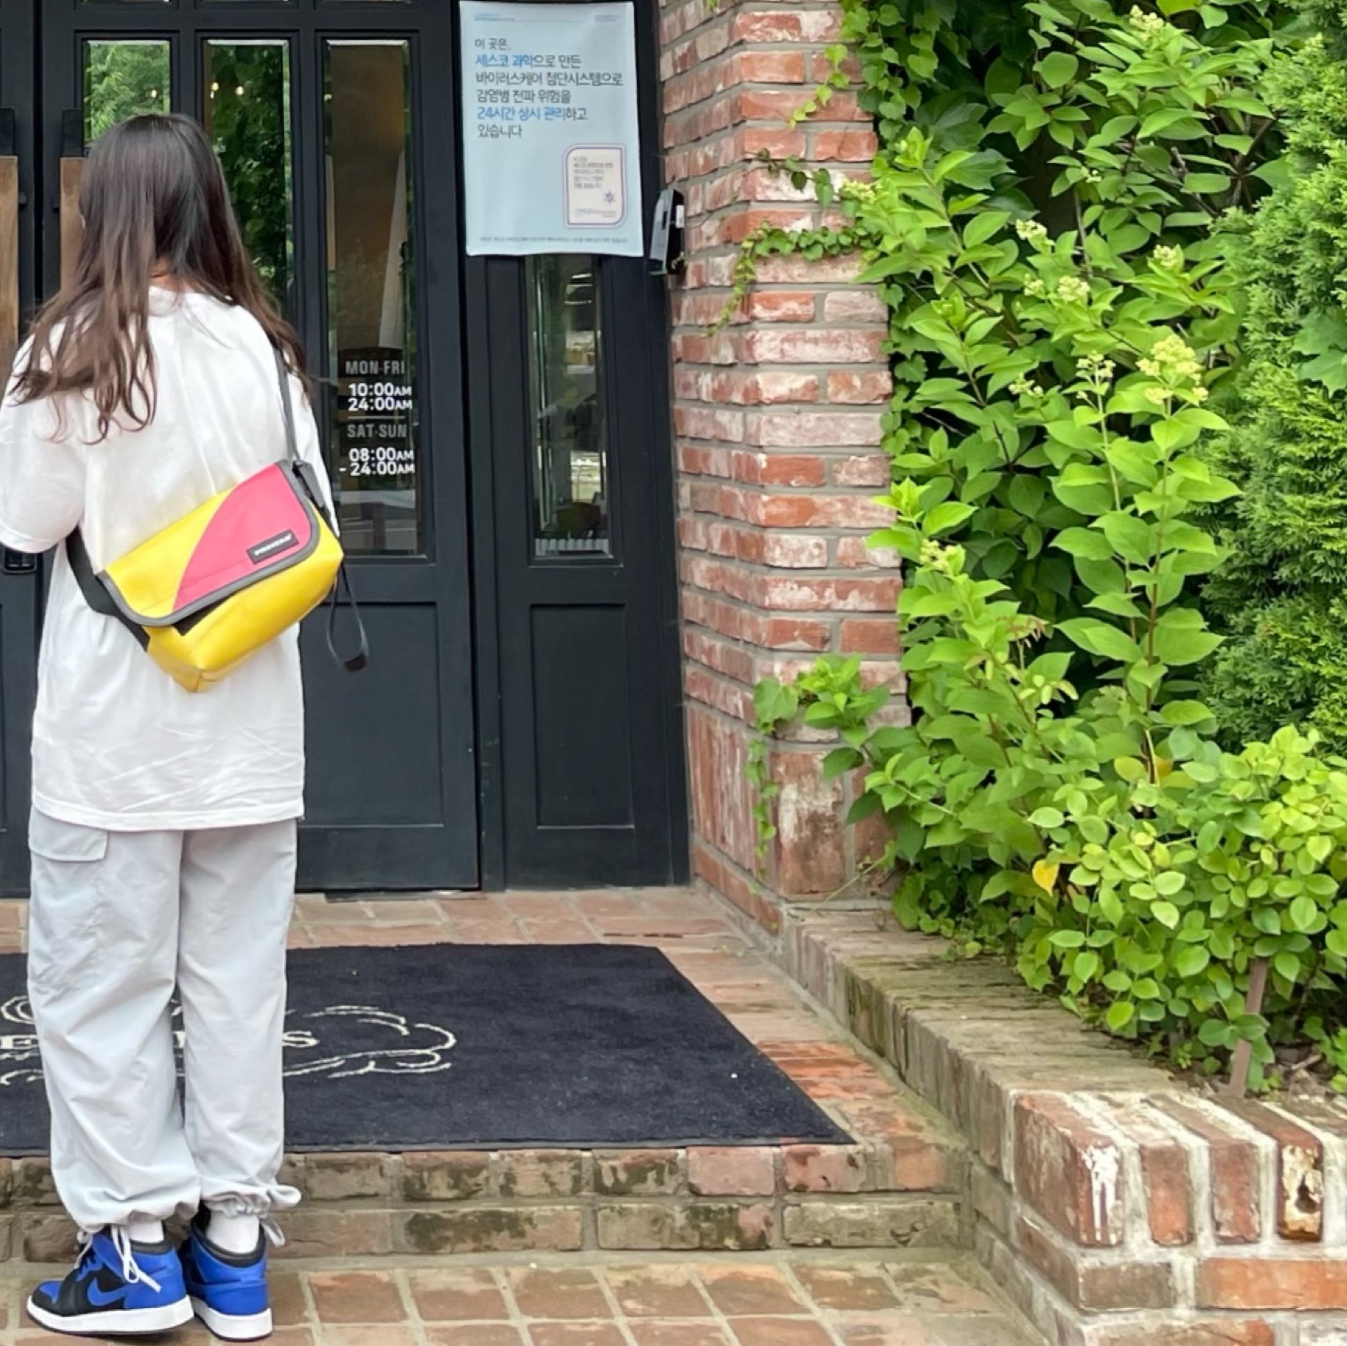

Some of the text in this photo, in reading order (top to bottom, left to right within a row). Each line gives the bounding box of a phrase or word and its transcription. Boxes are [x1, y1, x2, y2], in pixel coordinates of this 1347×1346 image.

[474, 38, 485, 49] 이
[476, 55, 581, 68] 세스코 과학으로 만든
[476, 72, 543, 85] 바이러스케어
[477, 89, 510, 103] 감염병
[513, 90, 535, 103] 전파
[477, 107, 588, 120] 24시간 상시 관리하고
[477, 124, 522, 138] 있습니다
[348, 382, 412, 396] 10:00AM
[348, 397, 413, 411] 24:00AM
[349, 447, 414, 461] 08:00AM
[350, 461, 415, 476] 24:00AM
